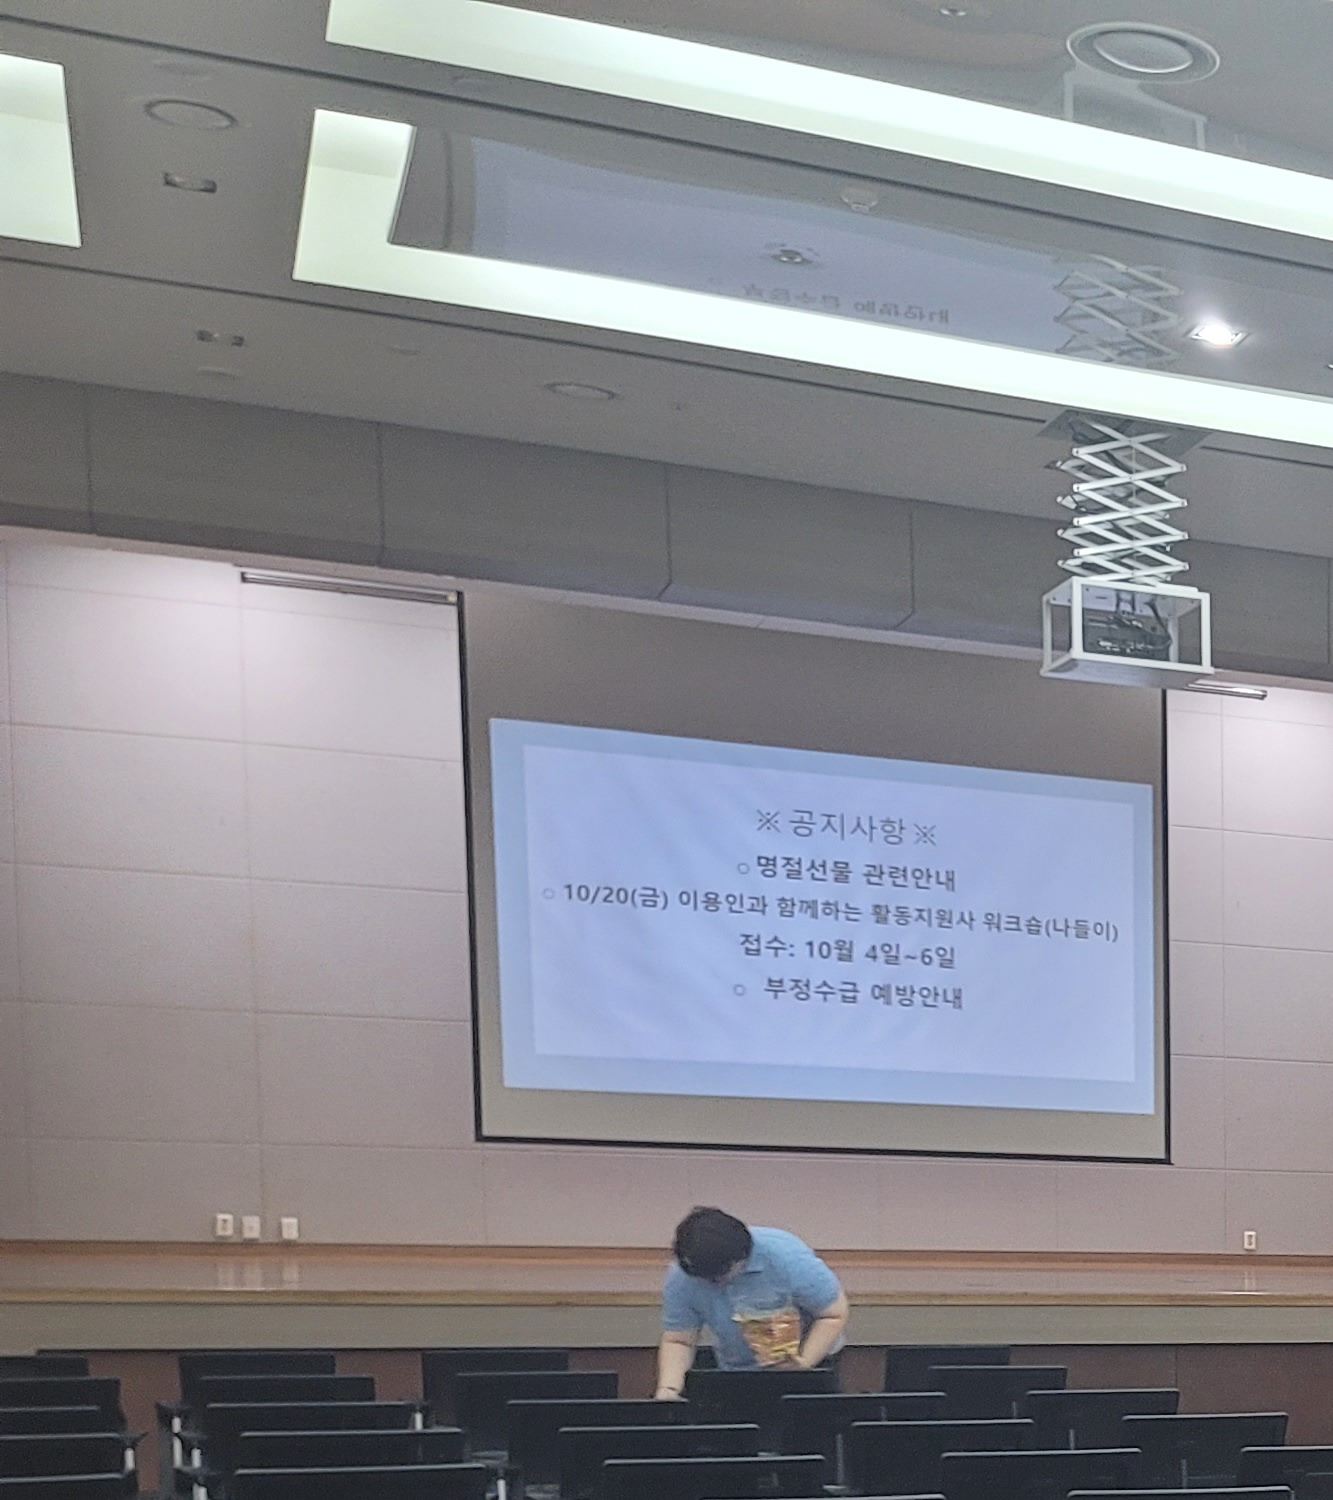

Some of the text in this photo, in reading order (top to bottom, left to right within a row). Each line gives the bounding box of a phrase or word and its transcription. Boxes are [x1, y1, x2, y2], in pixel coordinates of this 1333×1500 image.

[788, 808, 906, 846] 공지사항
[756, 855, 956, 892] 명절선물 관련안내
[563, 884, 669, 910] 10/20(금)
[678, 889, 768, 916] 이용인과
[776, 896, 863, 923] 함께하는
[870, 903, 976, 931] 활동지원사
[739, 933, 956, 970] 접수: 10월 4일~6일
[763, 976, 964, 1010] 부정수급 예방안내
